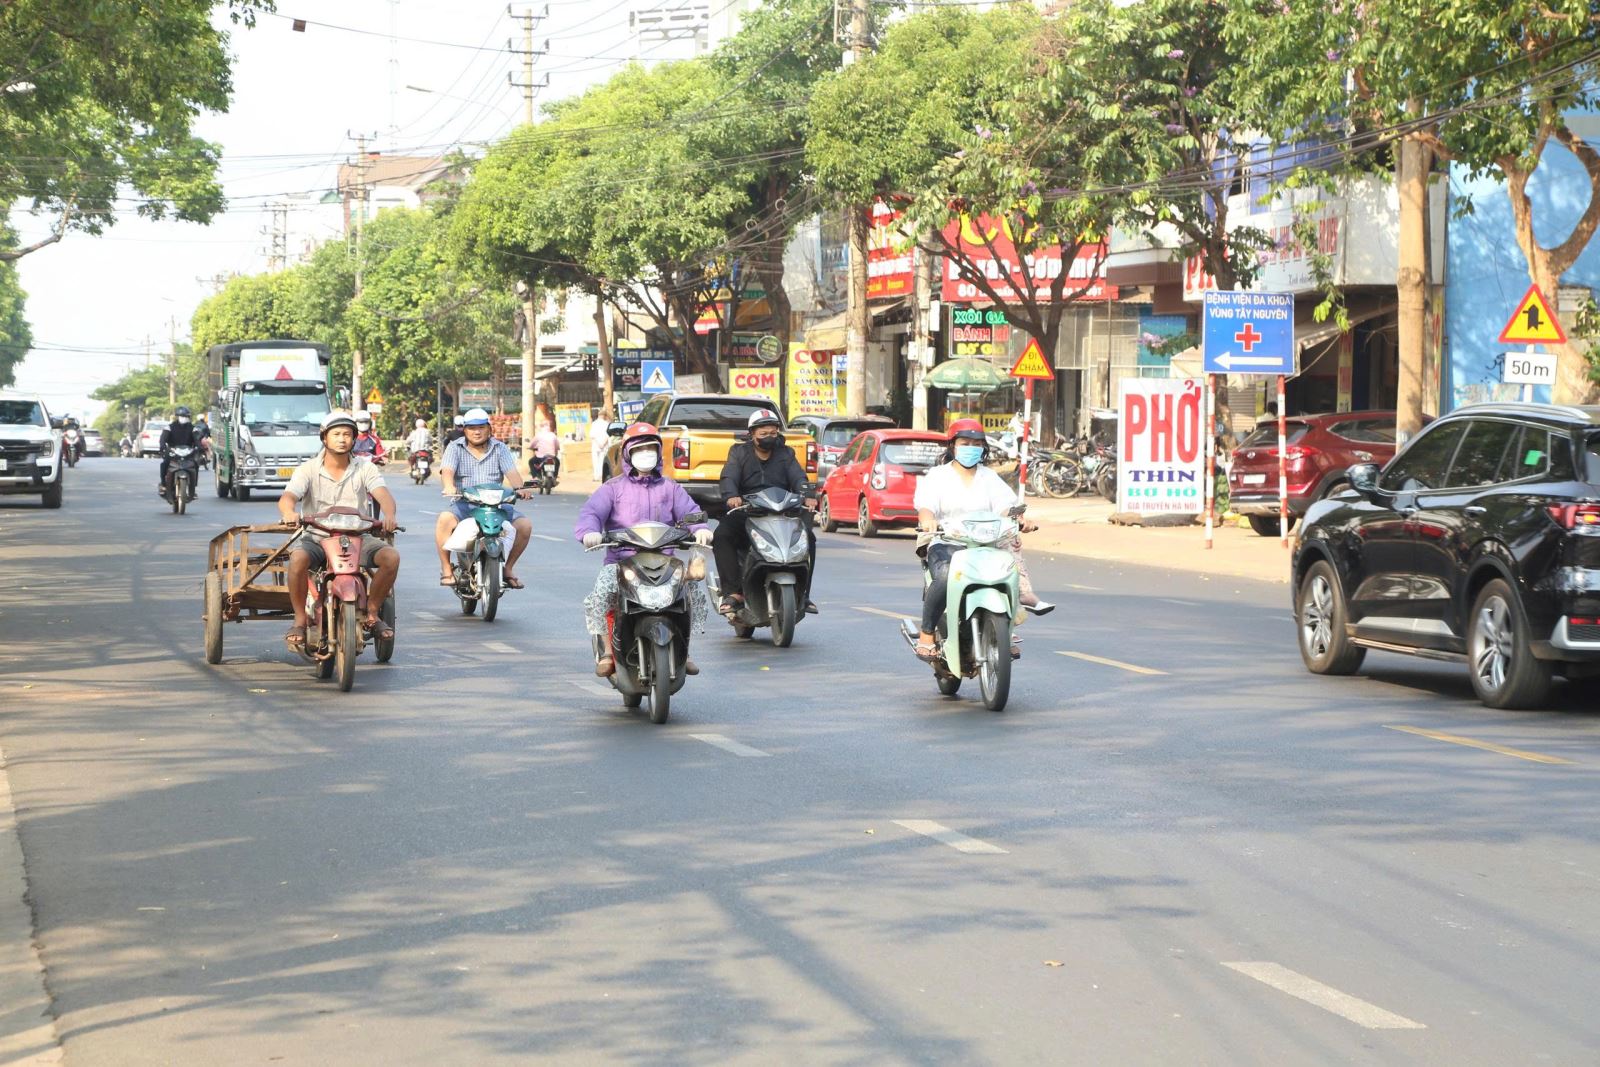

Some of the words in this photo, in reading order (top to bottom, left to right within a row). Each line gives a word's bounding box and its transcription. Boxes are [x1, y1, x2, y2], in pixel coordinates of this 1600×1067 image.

[1206, 292, 1231, 305] BỆNH
[1232, 293, 1252, 306] VIỆN
[1254, 295, 1266, 305] ĐA
[1267, 295, 1291, 306] KHOA
[954, 308, 982, 324] XÔI
[1210, 306, 1233, 319] VÙNG
[1235, 307, 1252, 319] TÂY
[1253, 308, 1288, 320] NGUYÊN
[953, 325, 991, 342] BÁNH
[1028, 352, 1037, 360] ĐI
[735, 373, 775, 389] CƠM
[1124, 379, 1202, 464] PHỞ
[1128, 466, 1196, 482] THÌN
[1128, 502, 1140, 511] GIA
